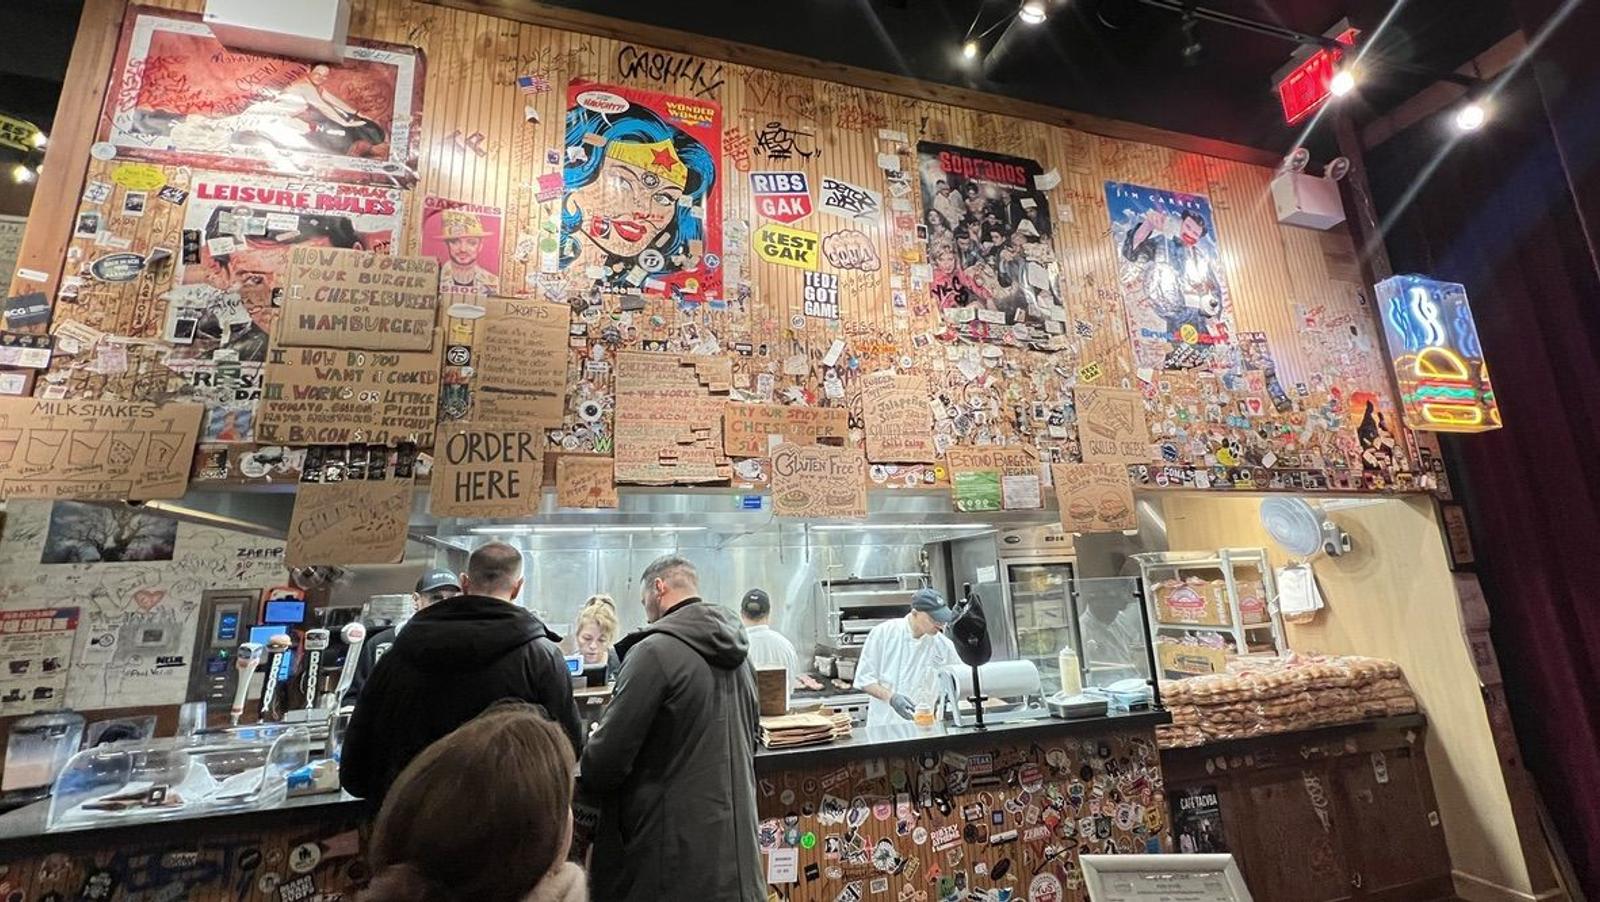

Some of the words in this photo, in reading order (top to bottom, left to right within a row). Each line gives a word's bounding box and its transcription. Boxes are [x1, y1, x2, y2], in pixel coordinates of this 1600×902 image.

[666, 101, 715, 116] WONDER
[668, 109, 713, 123] WOMAN
[754, 175, 804, 192] RIBS
[197, 183, 311, 208] LEISURE
[316, 194, 397, 215] RULES
[1117, 188, 1139, 200] JIM
[1148, 194, 1201, 209] CARREY
[762, 199, 806, 217] GAK
[762, 231, 817, 251] KEST
[292, 248, 338, 267] HOW
[764, 245, 809, 263] GAK
[299, 266, 347, 283] YOUR
[358, 271, 427, 289] BURGER
[805, 287, 838, 302] GOT
[353, 306, 370, 314] OR
[805, 302, 839, 319] GAME
[299, 314, 428, 335] HAMBURGER
[301, 349, 337, 366] HOW
[347, 351, 366, 367] DO
[370, 354, 400, 367] YOU
[315, 367, 365, 382] WANT
[293, 385, 354, 402] WORKS
[358, 391, 380, 402] OR
[31, 402, 156, 418] MILKSHAKES
[730, 407, 757, 418] TRY
[760, 408, 783, 418] OUR
[788, 409, 819, 421] SPICY
[381, 417, 435, 430] KETCHUP
[290, 425, 350, 443] BACON
[446, 431, 538, 464] ORDER
[949, 451, 993, 468] BEYOND
[993, 452, 1035, 468] BURGER
[455, 469, 521, 503] HERE
